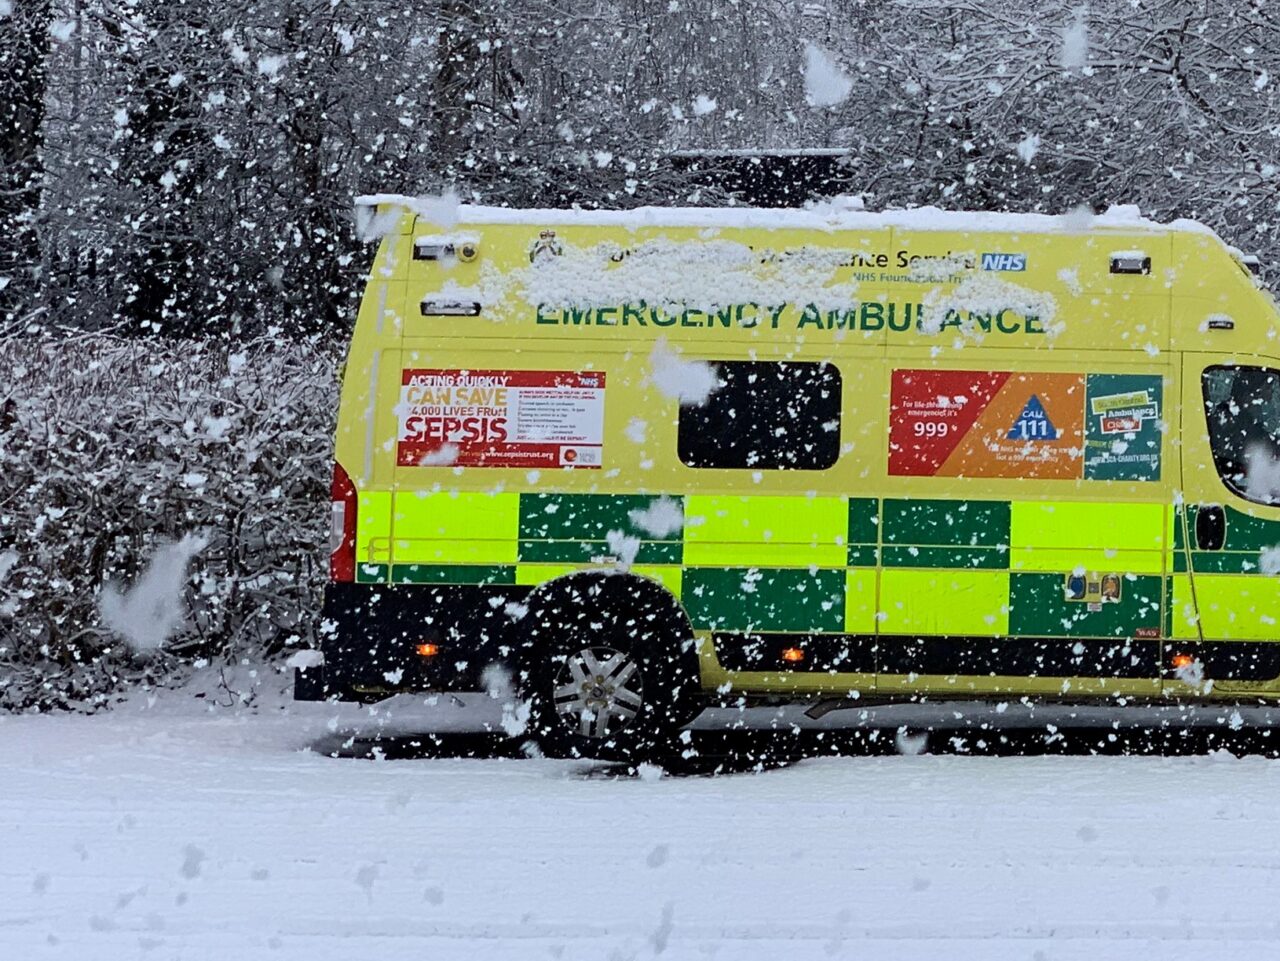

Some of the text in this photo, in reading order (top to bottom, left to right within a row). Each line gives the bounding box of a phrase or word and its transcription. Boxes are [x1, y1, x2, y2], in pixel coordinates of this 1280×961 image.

[983, 254, 1025, 270] NHS
[853, 273, 876, 282] NHS
[536, 300, 786, 329] EMERGENCY
[410, 375, 509, 387] ACTING QUICKLY
[407, 387, 508, 406] CAN SAVE
[903, 400, 913, 408] For
[443, 407, 474, 416] LIVES
[1022, 410, 1044, 418] CALL
[1108, 407, 1154, 418] Ambulance
[404, 417, 508, 442] SEPSIS
[914, 422, 948, 437] 999
[1017, 420, 1047, 437] 111
[485, 451, 554, 461] www.sepsistrust.org
[1139, 629, 1157, 637] WAS
